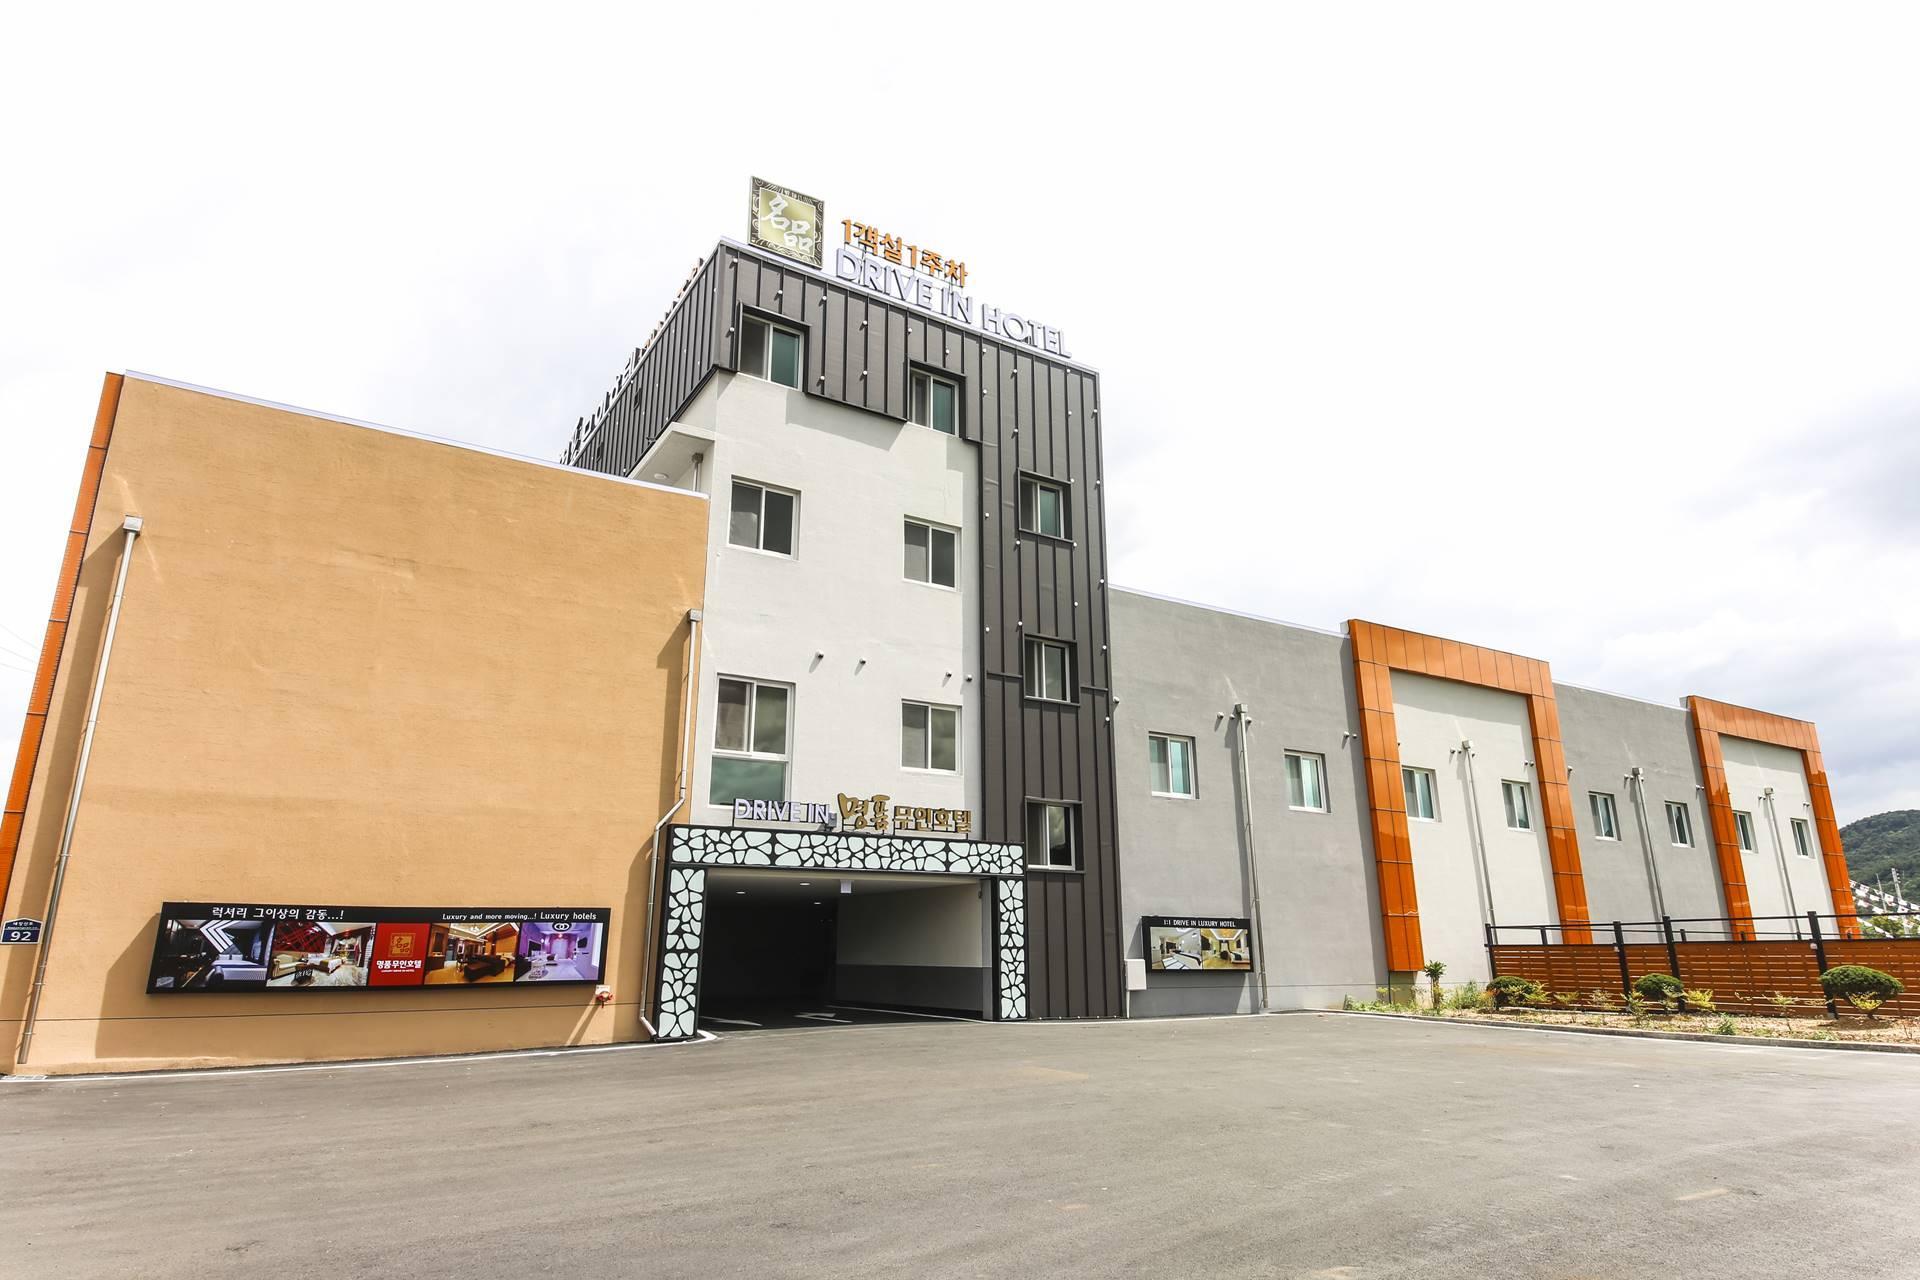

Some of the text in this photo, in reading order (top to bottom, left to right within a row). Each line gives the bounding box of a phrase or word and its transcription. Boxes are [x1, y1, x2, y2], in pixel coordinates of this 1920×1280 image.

[836, 248, 1072, 358] DRIVE IN HOTEL
[734, 798, 830, 824] DRIVE IN
[837, 792, 972, 833] 명품 무인호텔
[212, 907, 248, 919] 럭셔리
[253, 908, 300, 920] 그이상의
[442, 913, 468, 921] Luxury
[540, 912, 597, 921] Luxury hotels
[10, 931, 32, 941] 92
